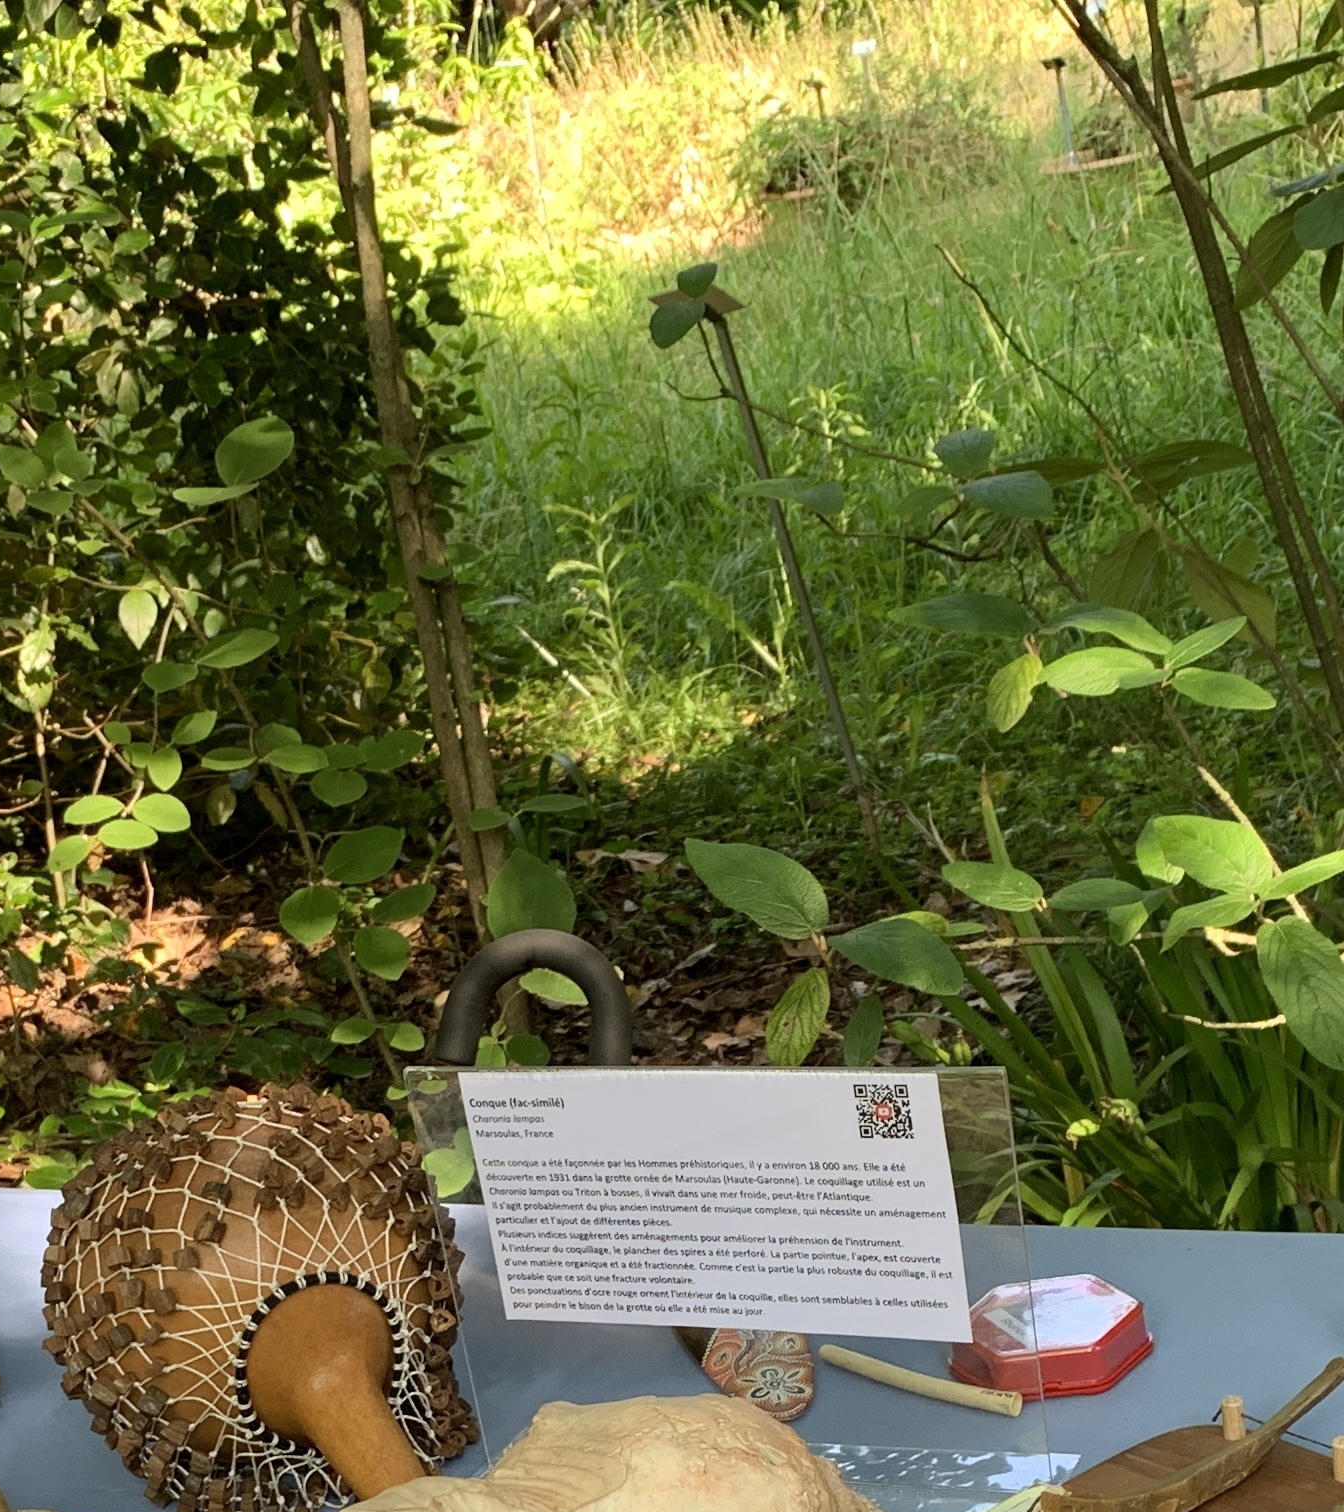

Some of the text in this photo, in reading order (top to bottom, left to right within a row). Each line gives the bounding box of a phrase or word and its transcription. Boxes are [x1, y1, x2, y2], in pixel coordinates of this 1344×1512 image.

[469, 1098, 565, 1109] Conque (fac-similé)
[473, 1115, 545, 1124] Charonia lampas
[476, 1129, 554, 1139] Marsoulas, France
[482, 1158, 506, 1167] Cette
[507, 1160, 539, 1168] conque
[549, 1159, 563, 1167] été
[565, 1159, 605, 1169] façonnée
[607, 1161, 622, 1169] par
[624, 1159, 637, 1168] les
[638, 1160, 678, 1168] Hommes
[680, 1160, 747, 1170] préhistoriques,
[772, 1162, 807, 1170] environ
[822, 1162, 840, 1171] 000
[863, 1162, 880, 1171] Elle
[891, 1163, 906, 1172] été
[486, 1173, 533, 1181] découverte
[549, 1173, 570, 1182] 1931
[572, 1174, 593, 1182] dans
[605, 1175, 631, 1184] grotte
[634, 1174, 660, 1183] ornée
[675, 1175, 721, 1184] Marsoulas
[817, 1178, 864, 1188] coquillage
[866, 1178, 894, 1187] utilisé
[489, 1187, 527, 1196] Charonia
[529, 1188, 560, 1197] lampas
[575, 1188, 602, 1196] Triton
[611, 1188, 642, 1198] bosses,
[651, 1190, 676, 1198] vivait
[678, 1190, 699, 1198] dans
[740, 1190, 770, 1201] froide,
[772, 1191, 815, 1201] peut-être
[524, 1202, 584, 1211] probablement
[600, 1203, 617, 1212] plus
[650, 1204, 698, 1212] instrument
[714, 1207, 752, 1215] musique
[754, 1206, 800, 1216] complexe,
[803, 1208, 817, 1216] qui
[820, 1207, 862, 1216] nécessite
[879, 1208, 946, 1220] aménagement
[496, 1216, 538, 1225] particulier
[593, 1217, 641, 1226] différentes
[498, 1230, 536, 1238] Plusieurs
[538, 1231, 568, 1239] indices
[569, 1231, 612, 1241] suggèrent
[614, 1232, 629, 1240] des
[632, 1232, 698, 1243] aménagements
[700, 1235, 721, 1243] pour
[724, 1234, 766, 1243] améliorer
[779, 1236, 830, 1245] préhension
[566, 1246, 611, 1256] coquillage,
[624, 1246, 661, 1256] plancher
[663, 1247, 679, 1256] des
[681, 1248, 706, 1257] spires
[716, 1249, 730, 1257] été
[783, 1252, 809, 1260] partie
[812, 1253, 849, 1262] pointue,
[900, 1256, 941, 1264] couverte
[530, 1259, 563, 1267] matière
[565, 1261, 608, 1269] organique
[629, 1261, 642, 1269] été
[699, 1263, 733, 1272] Comme
[768, 1266, 794, 1274] partie
[807, 1266, 825, 1276] plus
[828, 1267, 862, 1276] robuste
[879, 1269, 929, 1280] coquillage,
[507, 1273, 544, 1281] probable
[612, 1274, 647, 1283] fracture
[510, 1286, 526, 1294] Des
[528, 1288, 583, 1296] ponctuations
[613, 1290, 637, 1298] rouge
[739, 1293, 776, 1303] coquille,
[778, 1294, 798, 1303] elles
[801, 1296, 820, 1304] sont
[822, 1296, 873, 1306] semblables
[883, 1298, 908, 1307] celles
[911, 1299, 948, 1309] utilisées
[535, 1301, 567, 1310] peindre
[578, 1302, 602, 1310] bison
[626, 1304, 652, 1313] grotte
[668, 1304, 683, 1312] elle
[693, 1305, 707, 1313] été
[709, 1306, 730, 1314] mise
